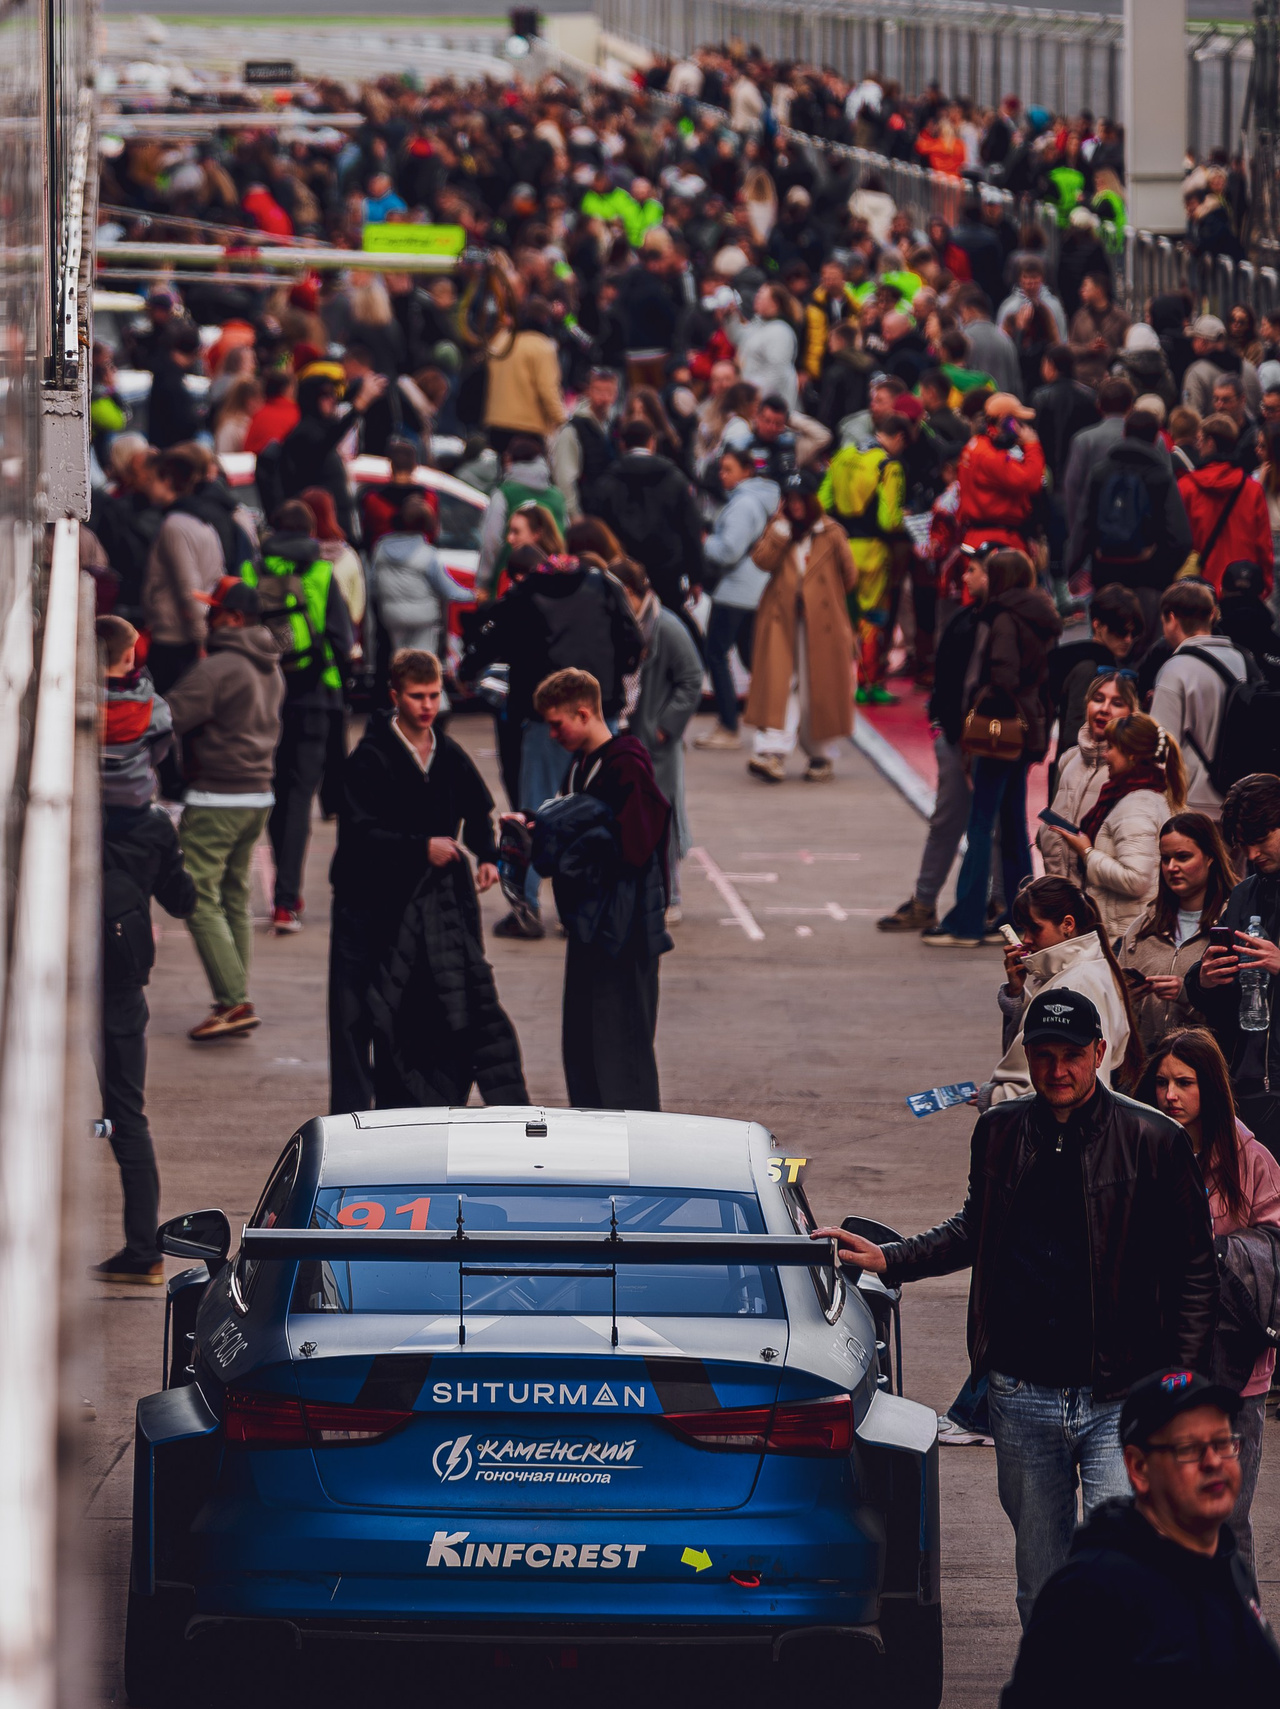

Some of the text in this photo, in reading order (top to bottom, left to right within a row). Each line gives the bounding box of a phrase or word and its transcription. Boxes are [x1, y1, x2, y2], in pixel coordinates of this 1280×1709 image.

[1042, 1016, 1071, 1025] BENTLEY
[336, 1197, 431, 1231] 91
[432, 1382, 645, 1408] SHTURMAN
[478, 1438, 637, 1464] КАМЕНСКИЙ
